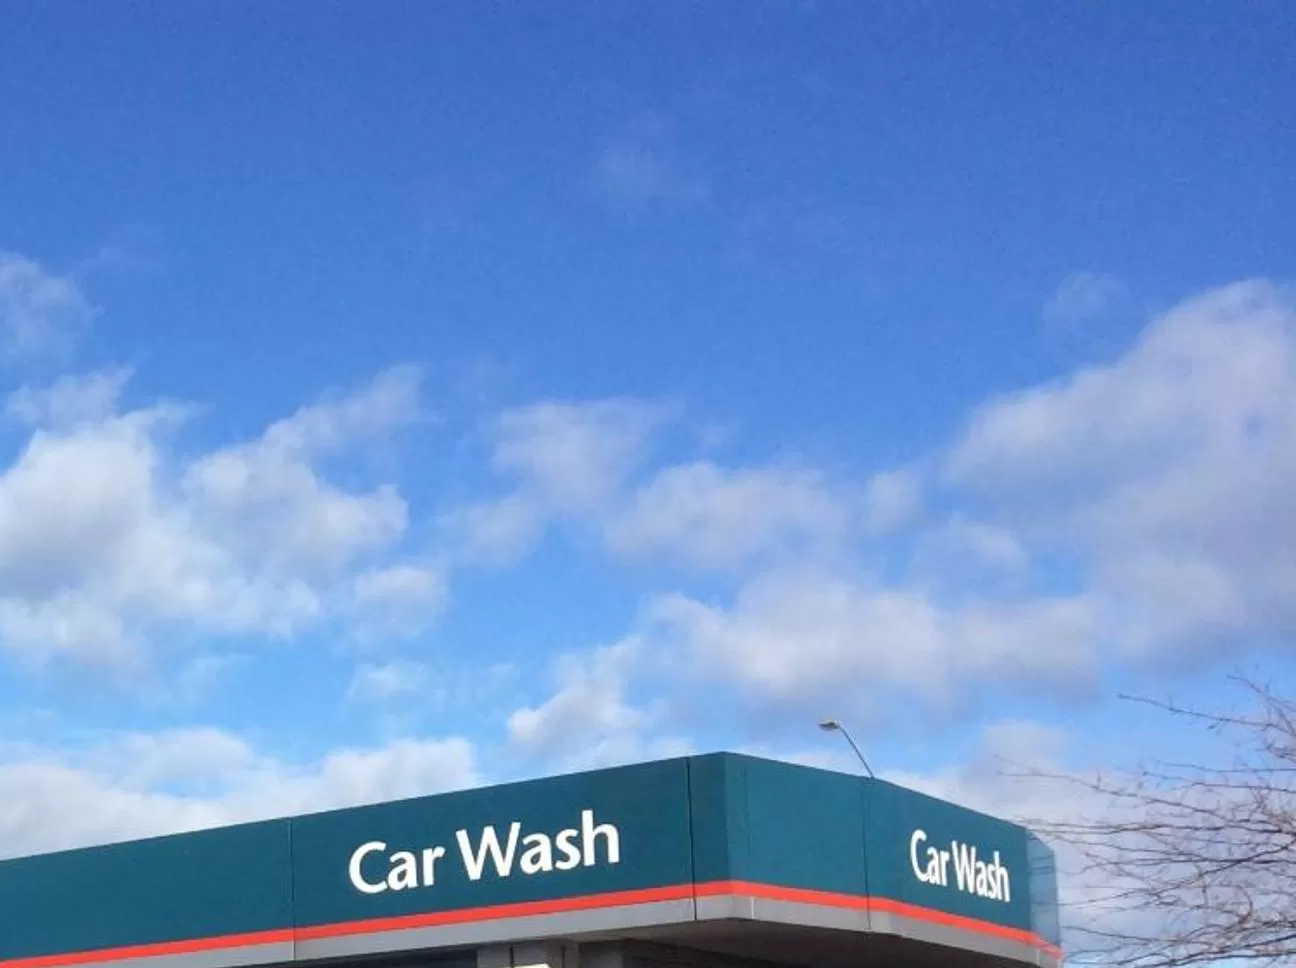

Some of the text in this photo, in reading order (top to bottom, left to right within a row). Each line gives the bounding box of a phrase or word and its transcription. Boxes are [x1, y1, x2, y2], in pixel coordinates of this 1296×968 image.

[349, 809, 621, 894] Car Wash
[910, 829, 1011, 903] Car Wash
